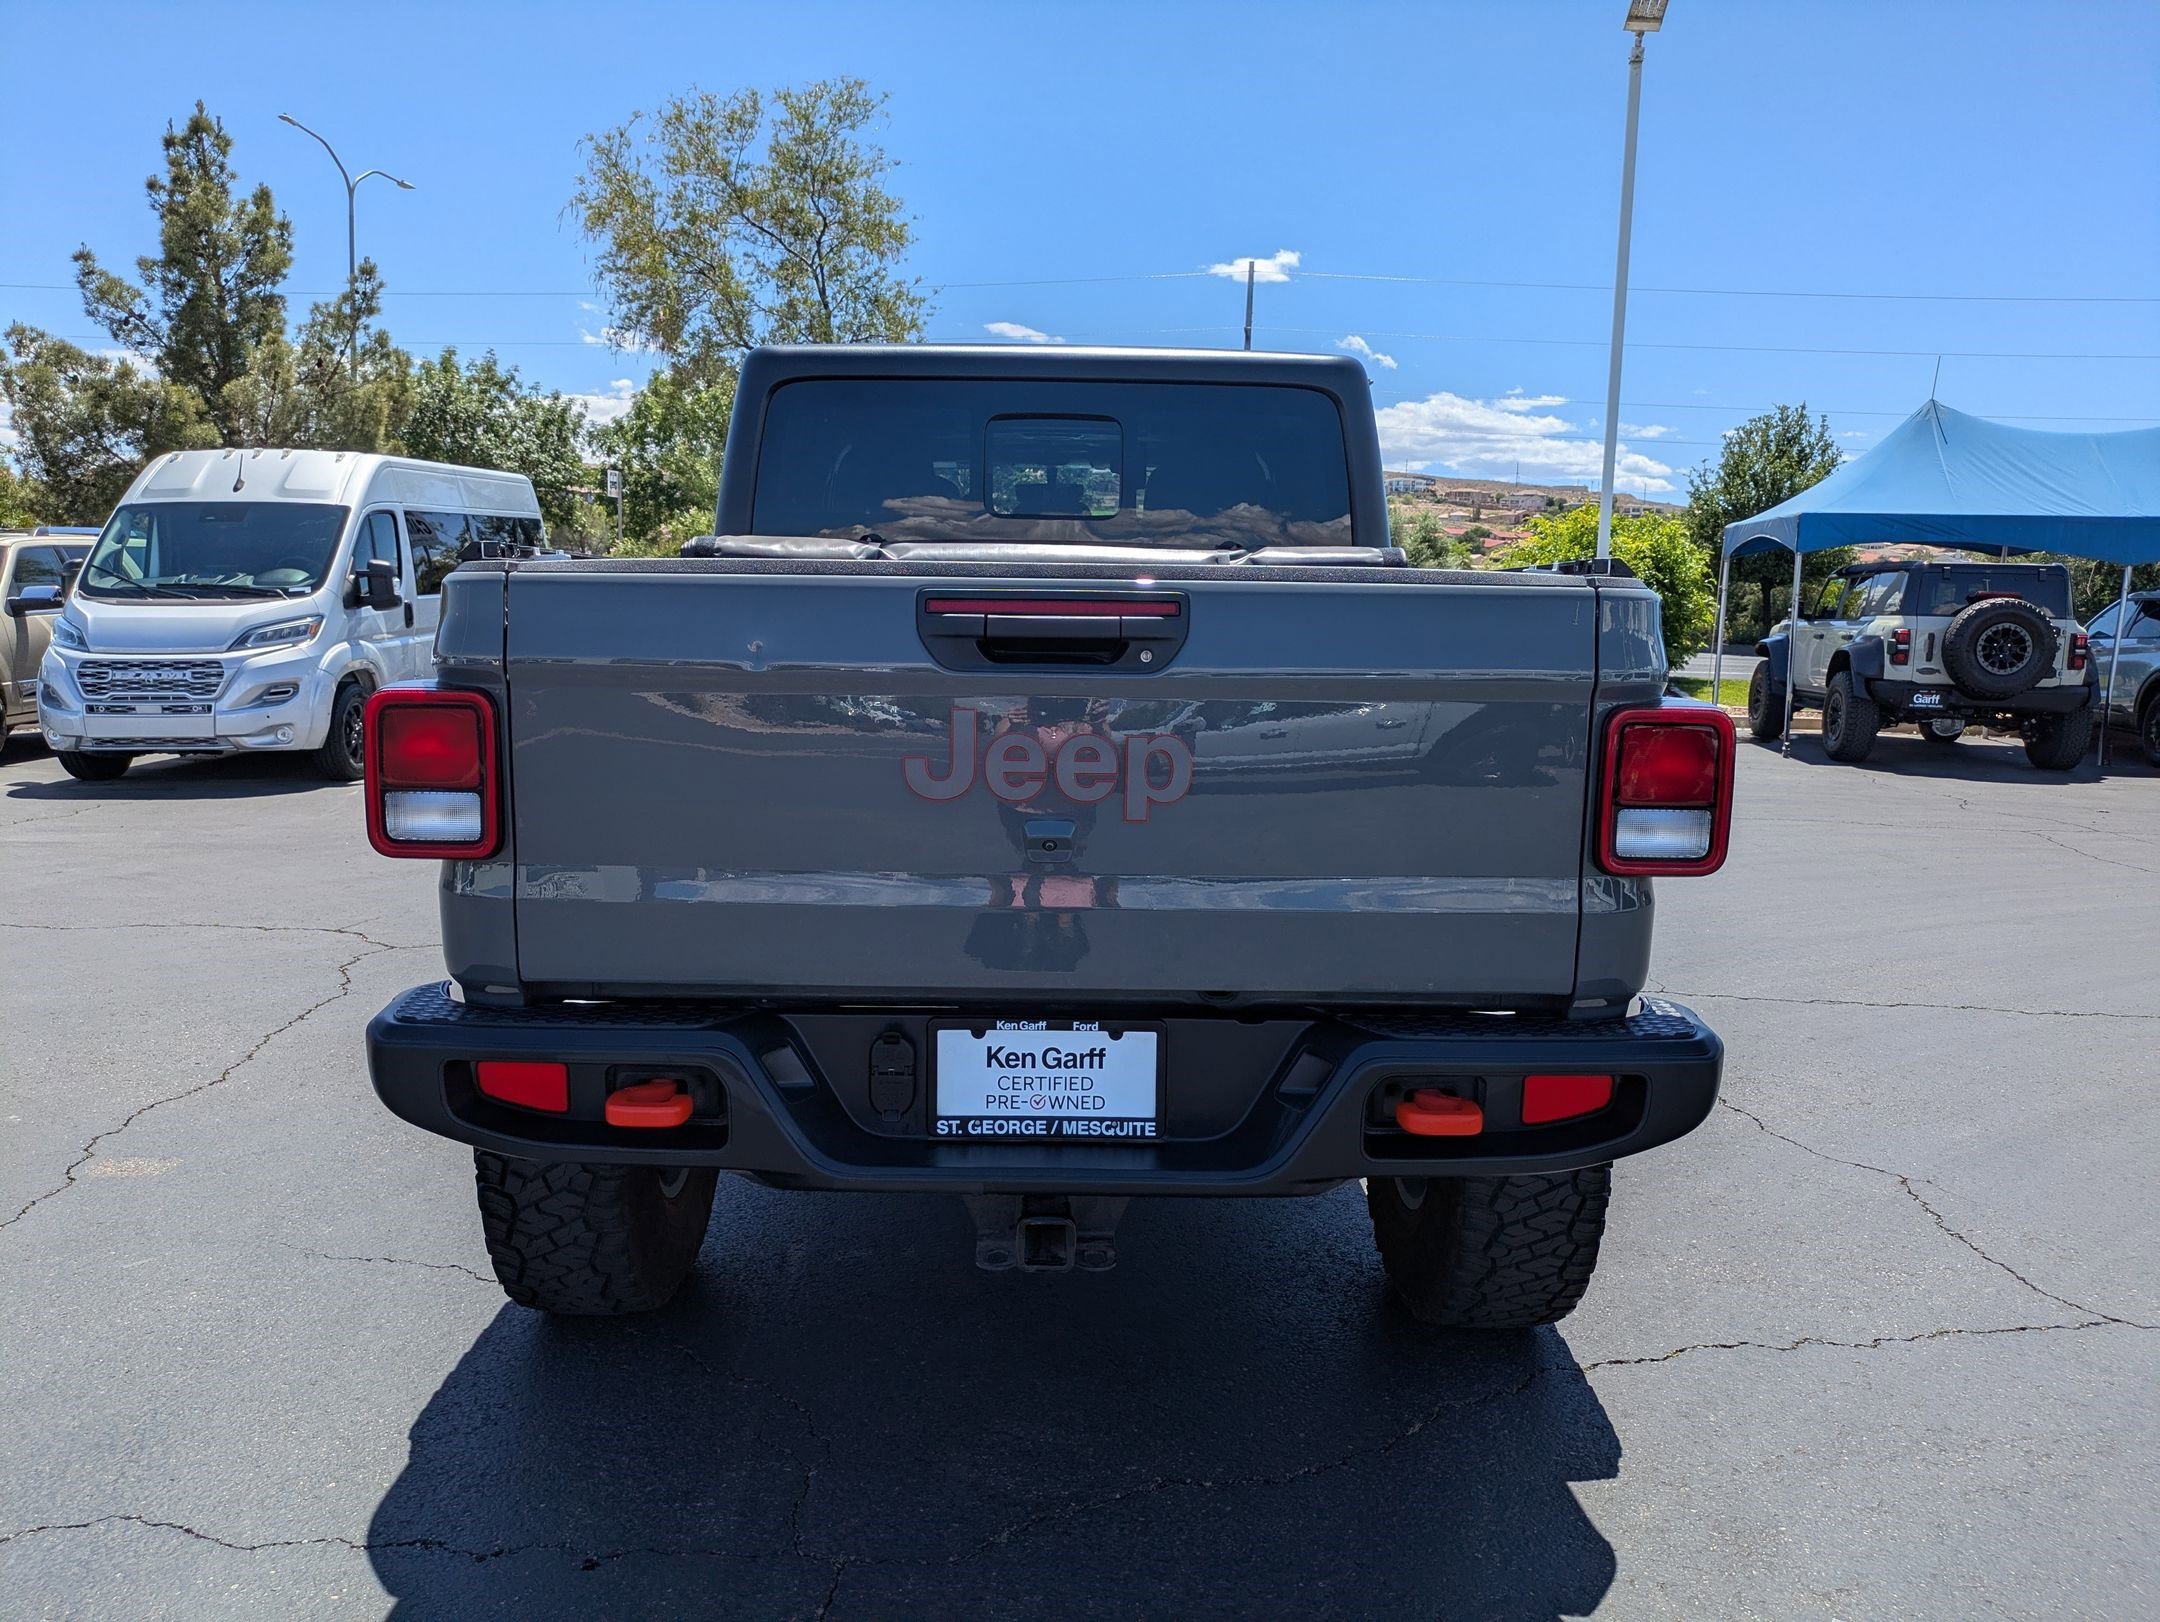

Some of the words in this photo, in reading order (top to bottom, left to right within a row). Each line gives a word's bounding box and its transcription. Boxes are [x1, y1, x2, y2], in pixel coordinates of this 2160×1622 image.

[1913, 694, 1940, 704] Garff
[903, 707, 1194, 824] Jeep
[996, 1020, 1018, 1031] Ken
[1019, 1020, 1047, 1031] Garff
[1073, 1021, 1099, 1031] Ford
[986, 1046, 1036, 1069] Ken
[1042, 1047, 1107, 1070] Garff
[997, 1076, 1094, 1091] CERTIFIED
[936, 1120, 962, 1135] ST.
[968, 1120, 1047, 1135] GEORGE
[1062, 1121, 1157, 1137] MESQUITE
